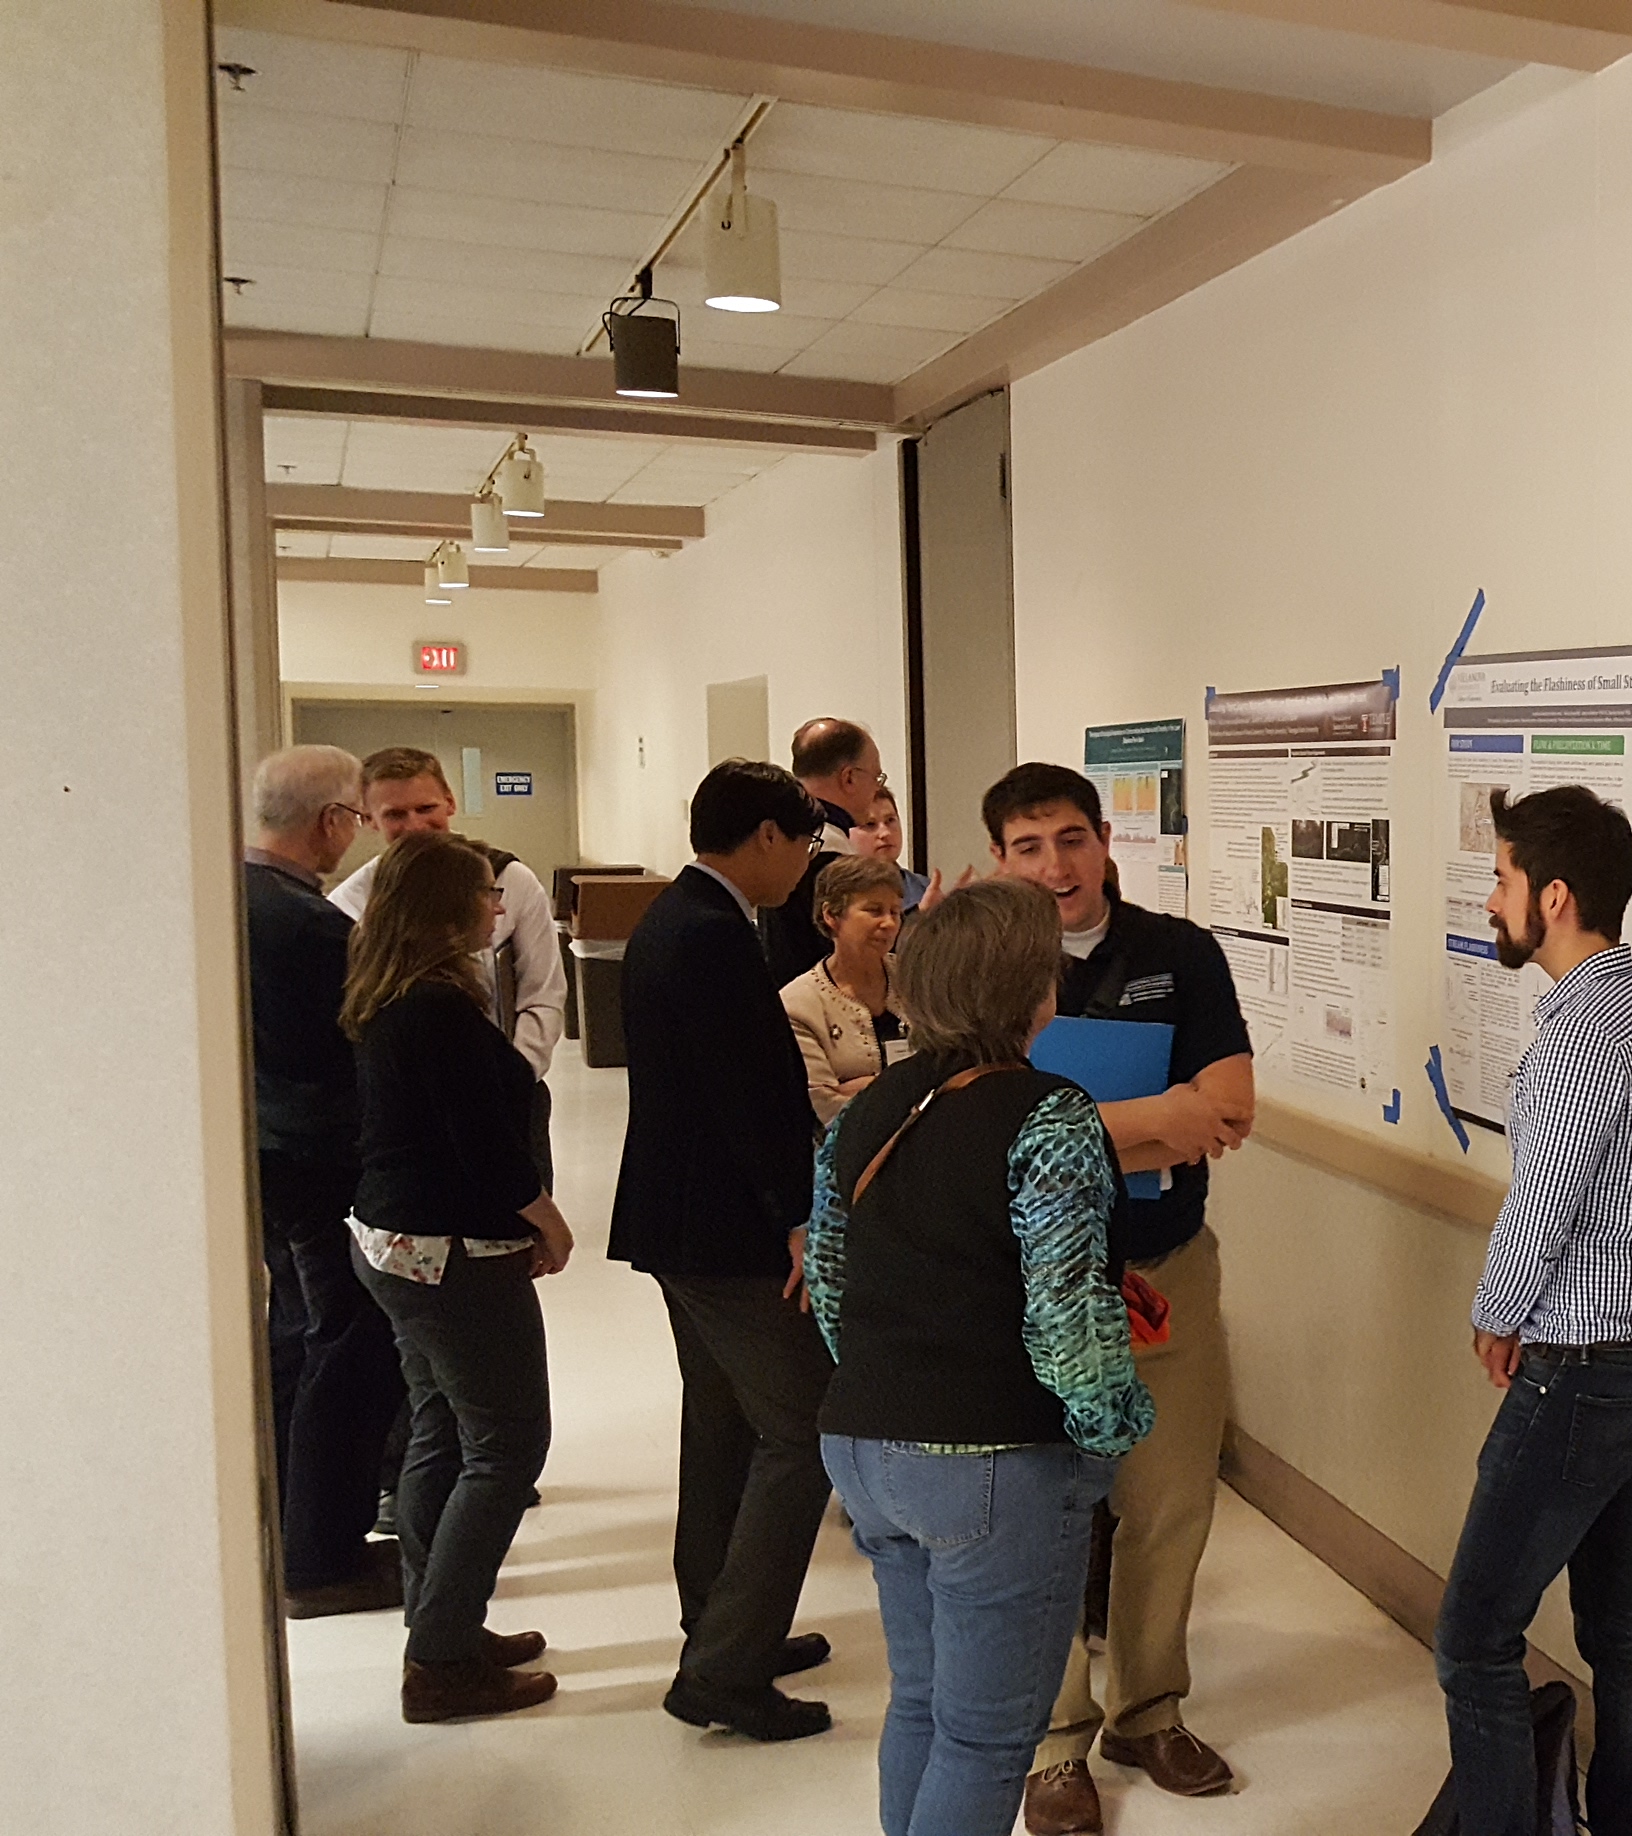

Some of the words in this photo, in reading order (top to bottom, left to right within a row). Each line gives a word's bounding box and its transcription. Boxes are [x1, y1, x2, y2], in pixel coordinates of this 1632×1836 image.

[422, 647, 458, 671] EXIT
[1530, 678, 1542, 692] the
[1586, 675, 1597, 690] of
[1596, 674, 1622, 690] Small
